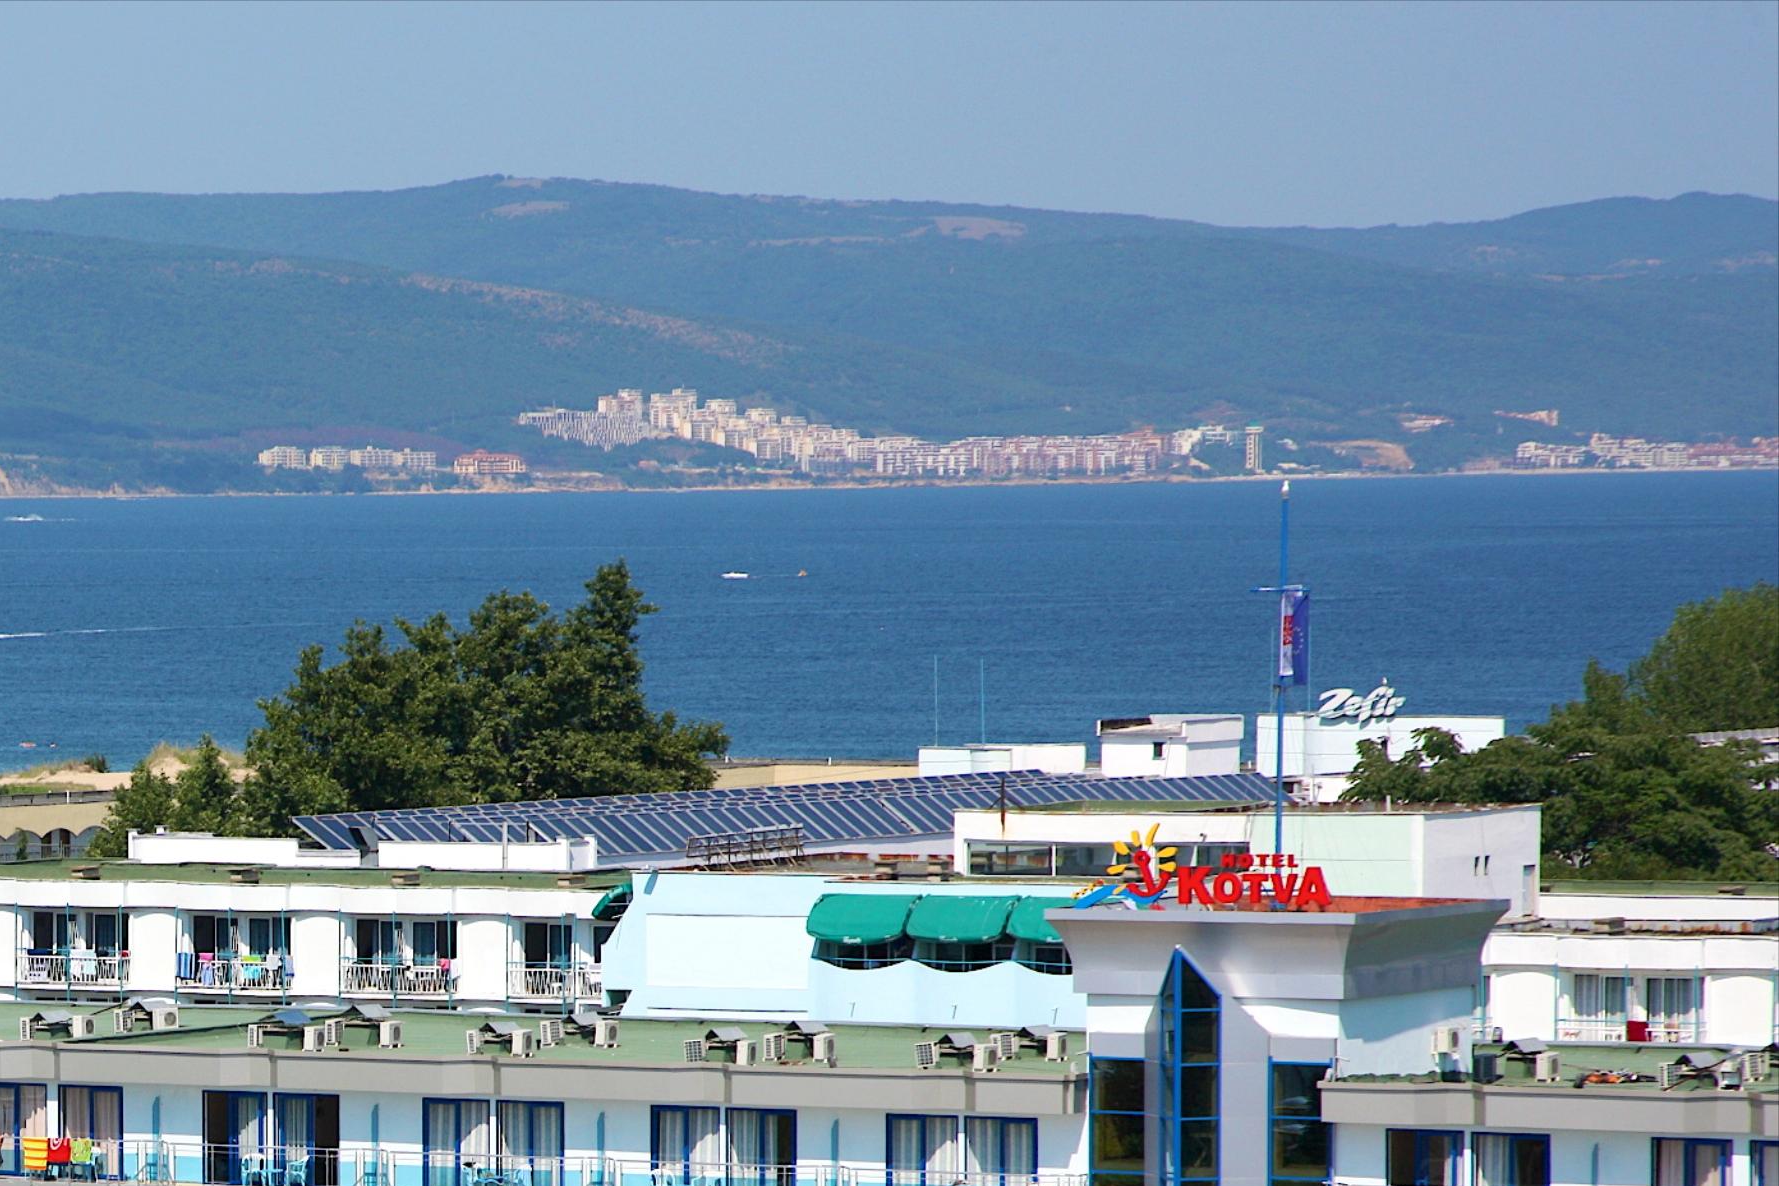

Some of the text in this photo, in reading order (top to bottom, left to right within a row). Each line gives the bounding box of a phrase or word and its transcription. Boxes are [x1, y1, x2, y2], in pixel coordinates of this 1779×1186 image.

[1318, 677, 1406, 722] Zefir
[1220, 854, 1299, 868] HOTEL
[1177, 866, 1332, 906] KOTVA
